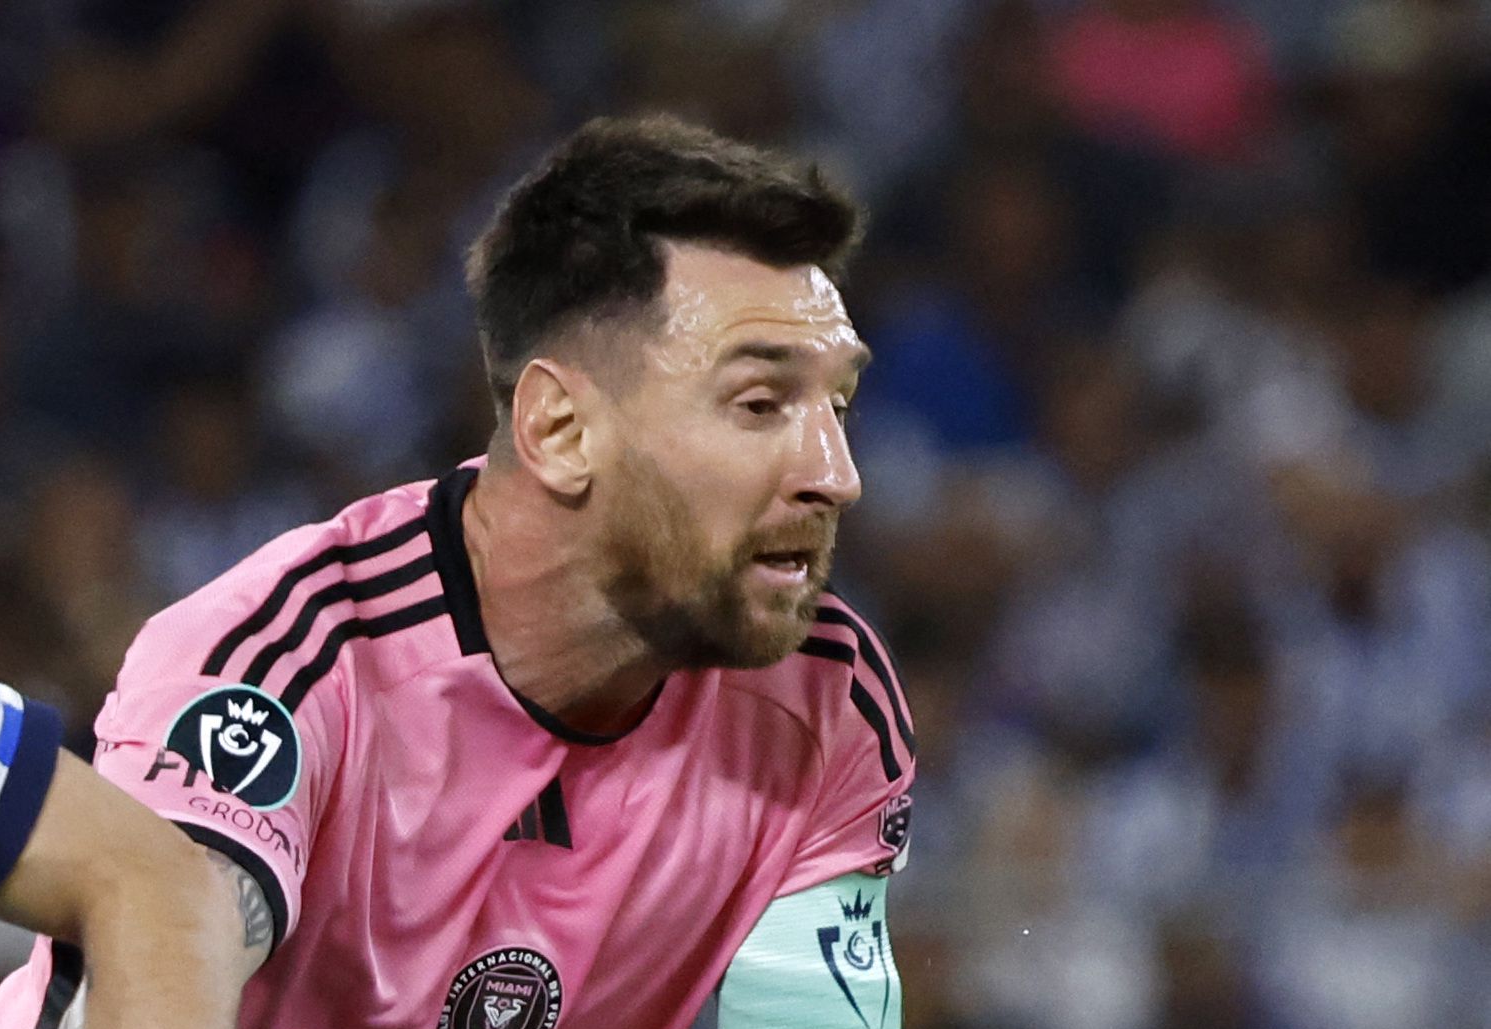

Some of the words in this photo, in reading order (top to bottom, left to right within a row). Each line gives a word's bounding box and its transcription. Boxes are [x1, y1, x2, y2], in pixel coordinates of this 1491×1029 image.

[449, 950, 552, 999] INTERNACIONAL
[548, 981, 560, 998] DE
[486, 979, 533, 997] MIAMI
